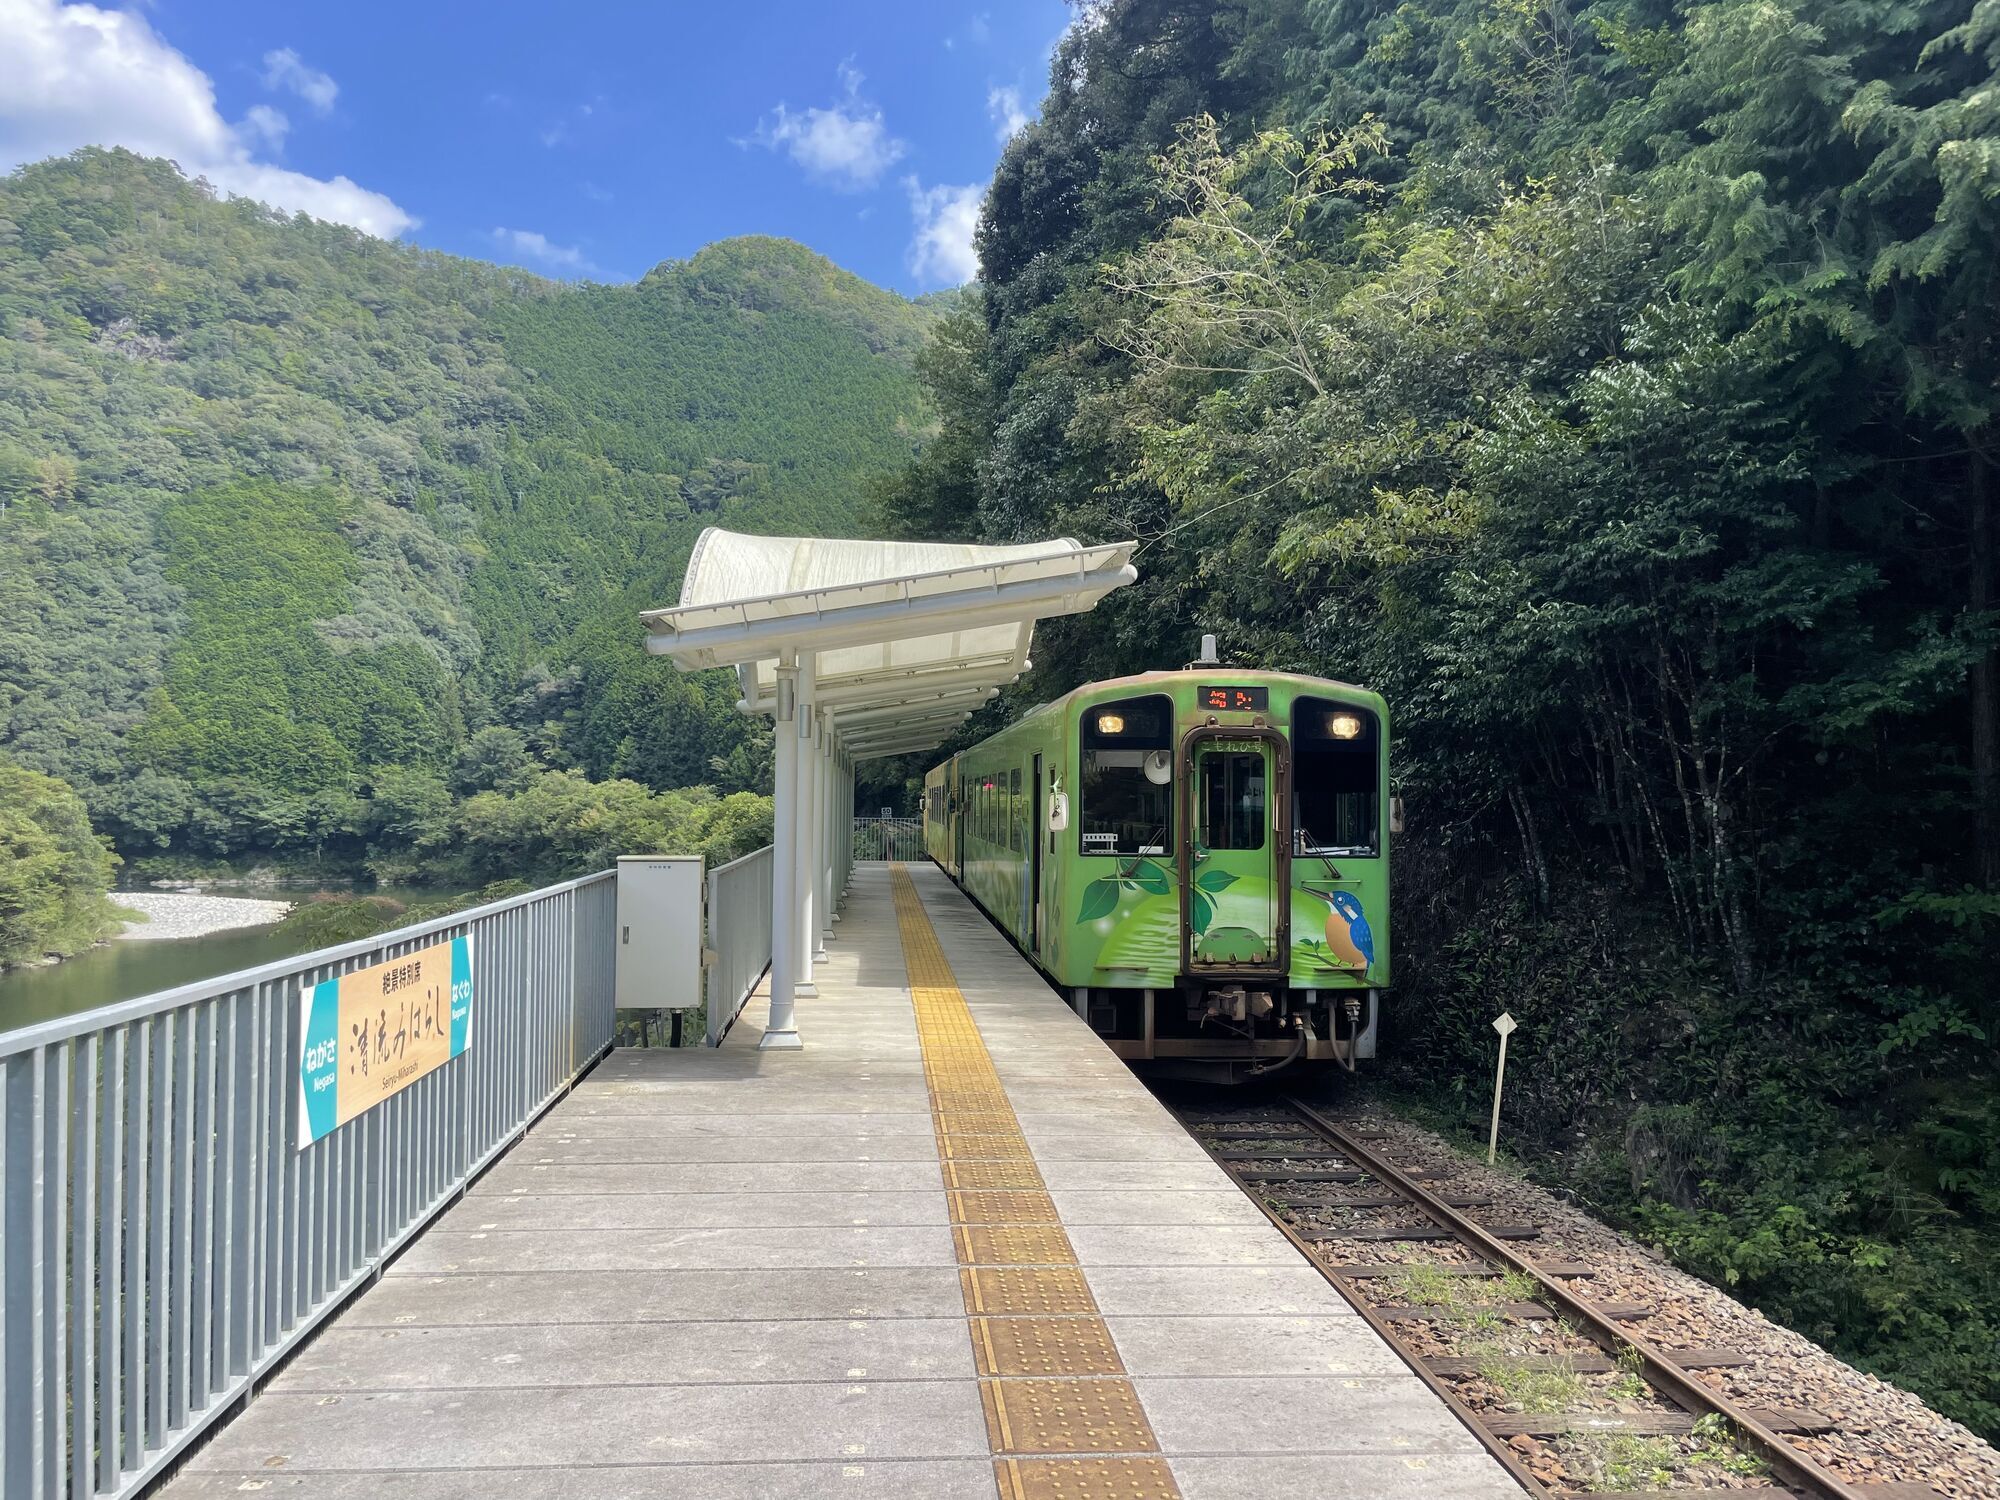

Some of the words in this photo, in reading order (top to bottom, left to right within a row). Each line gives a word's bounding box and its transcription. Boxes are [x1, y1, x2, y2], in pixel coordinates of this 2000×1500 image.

[452, 979, 470, 1003] なぐわ
[350, 985, 444, 1077] 清流みはらし
[306, 1037, 336, 1074] ねがさ
[313, 1072, 335, 1092] Negasa
